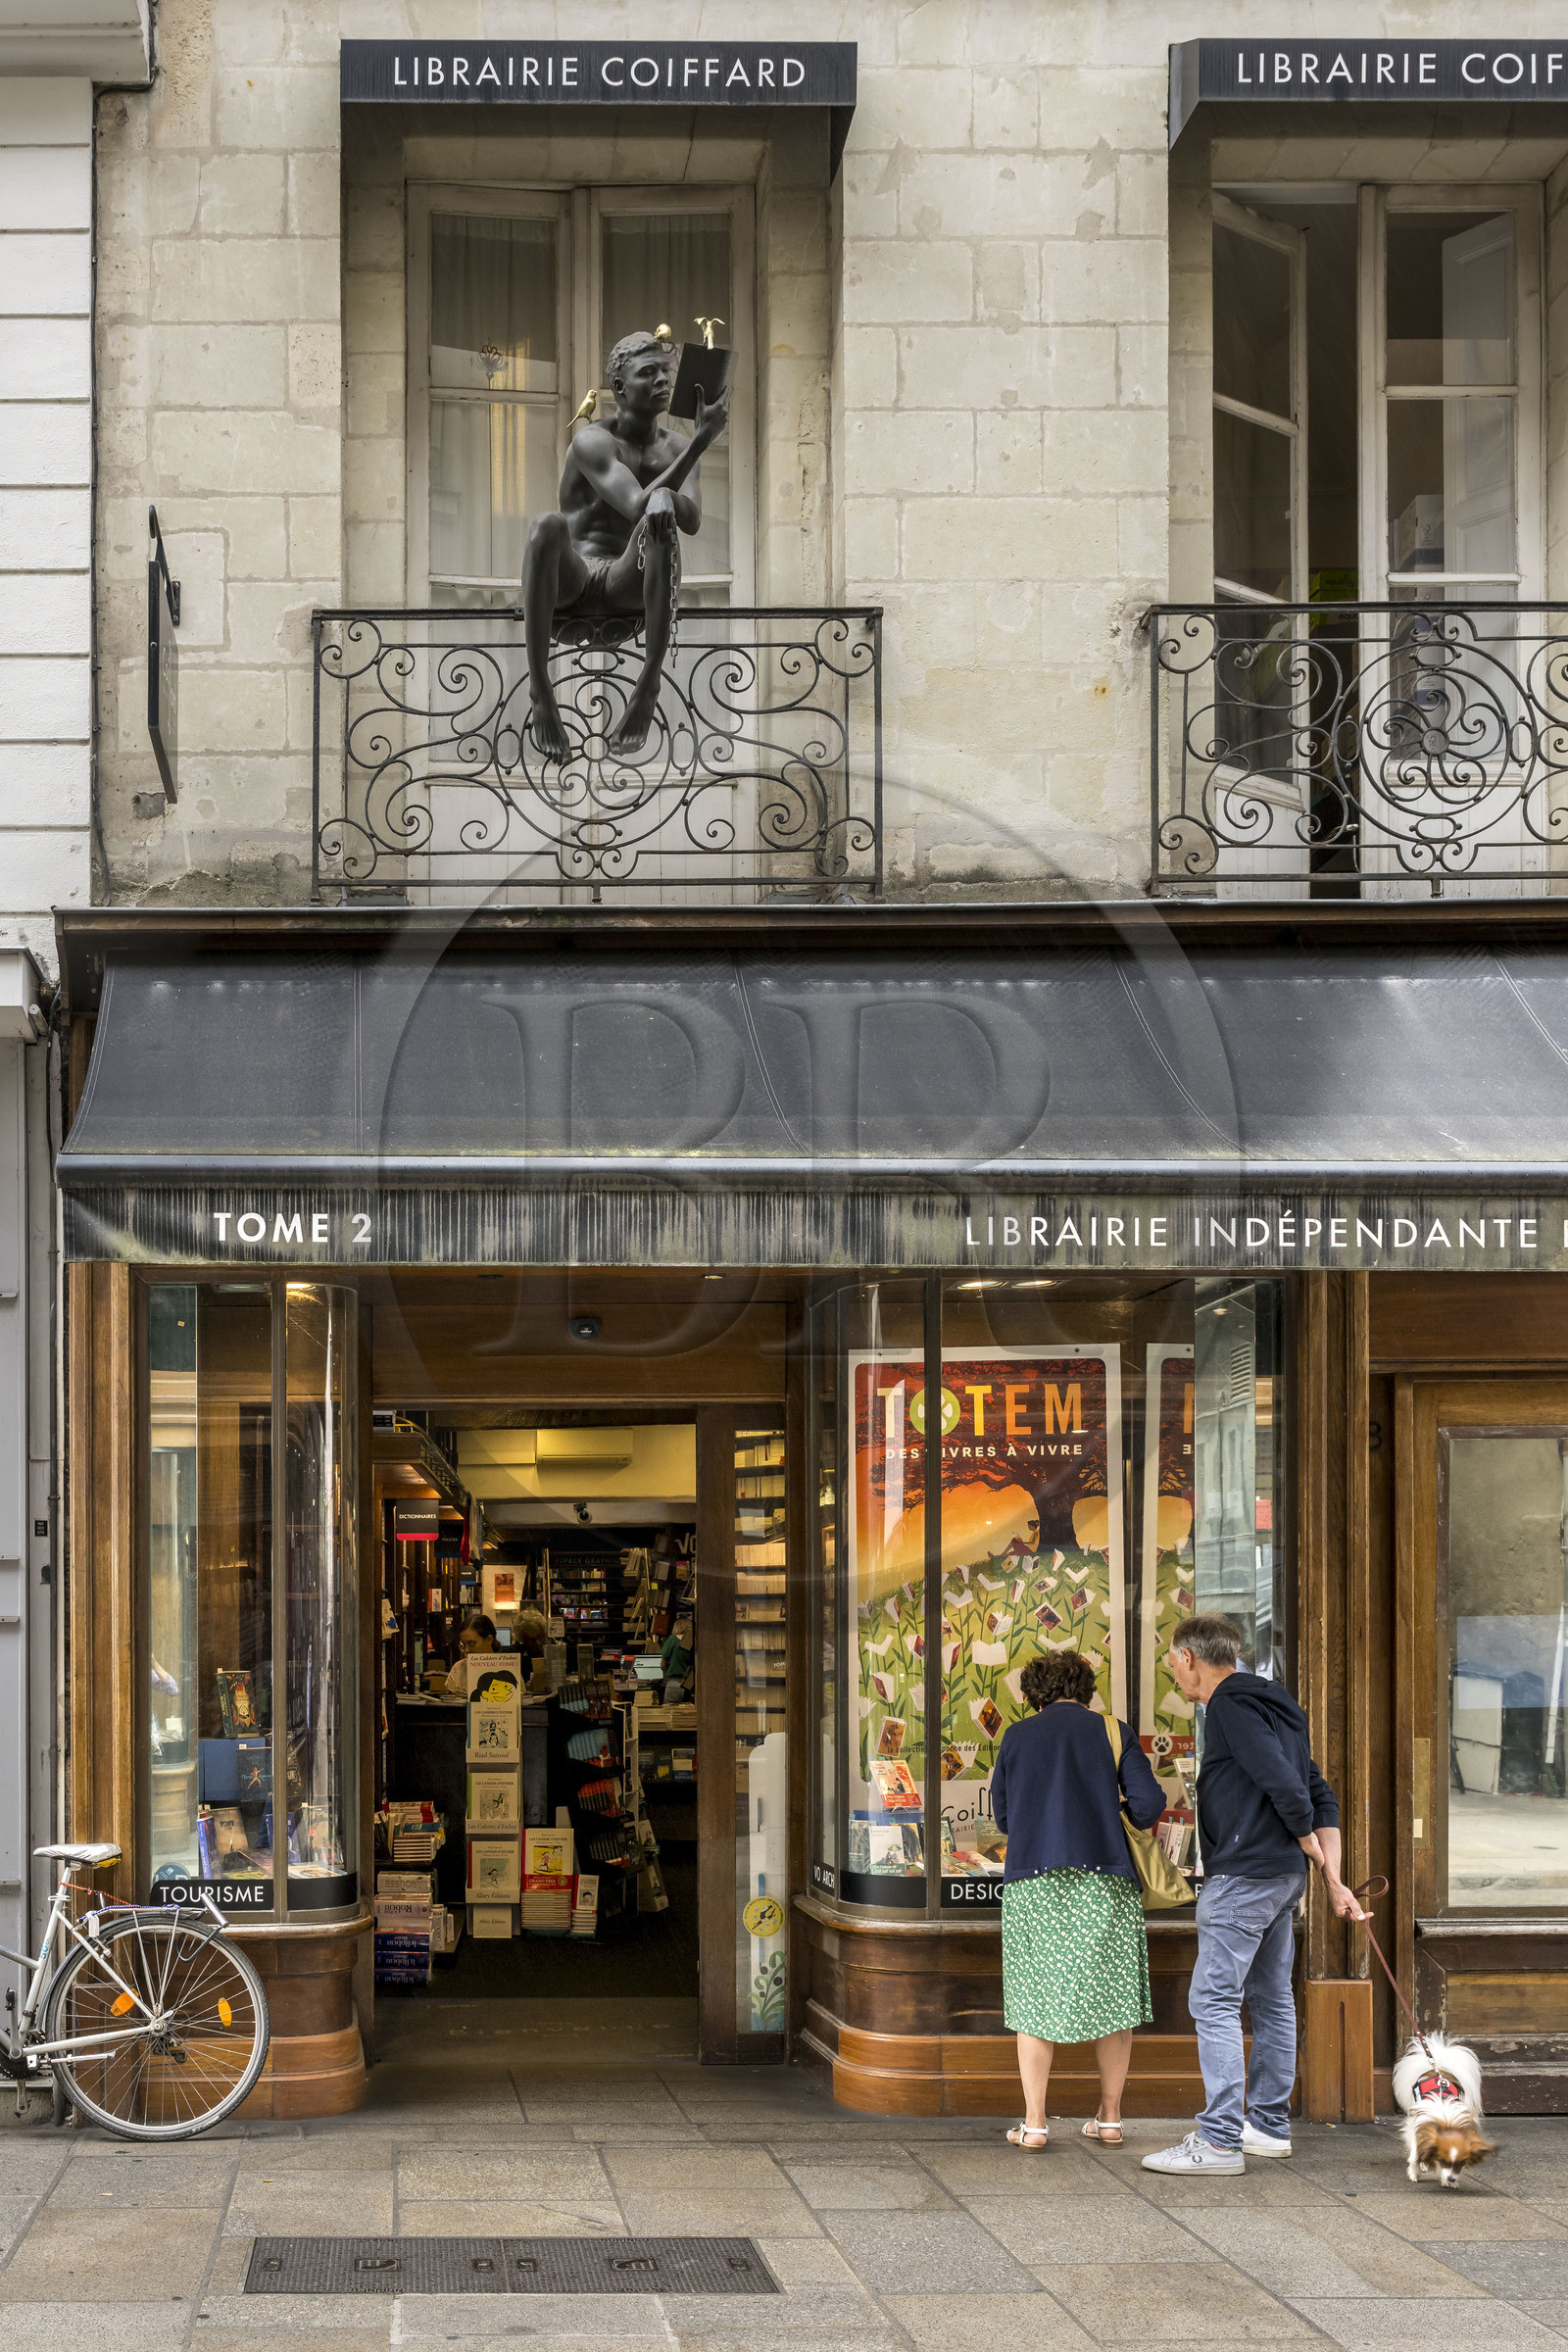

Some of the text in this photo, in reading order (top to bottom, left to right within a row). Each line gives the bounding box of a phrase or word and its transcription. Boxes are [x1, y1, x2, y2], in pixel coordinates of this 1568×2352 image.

[393, 56, 807, 88] LIBRAIRIE COIFFARD
[1237, 52, 1438, 84] LIBRAIRIE
[213, 1211, 372, 1244] TOME 2
[965, 1208, 1538, 1248] LIBRAIRIE INDÉPENDANTE
[885, 1443, 1083, 1460] DES IVRES À VIVRE
[896, 1744, 925, 1753] collectio
[952, 1824, 975, 1834] RAIRIE
[159, 1886, 264, 1902] TOURISME
